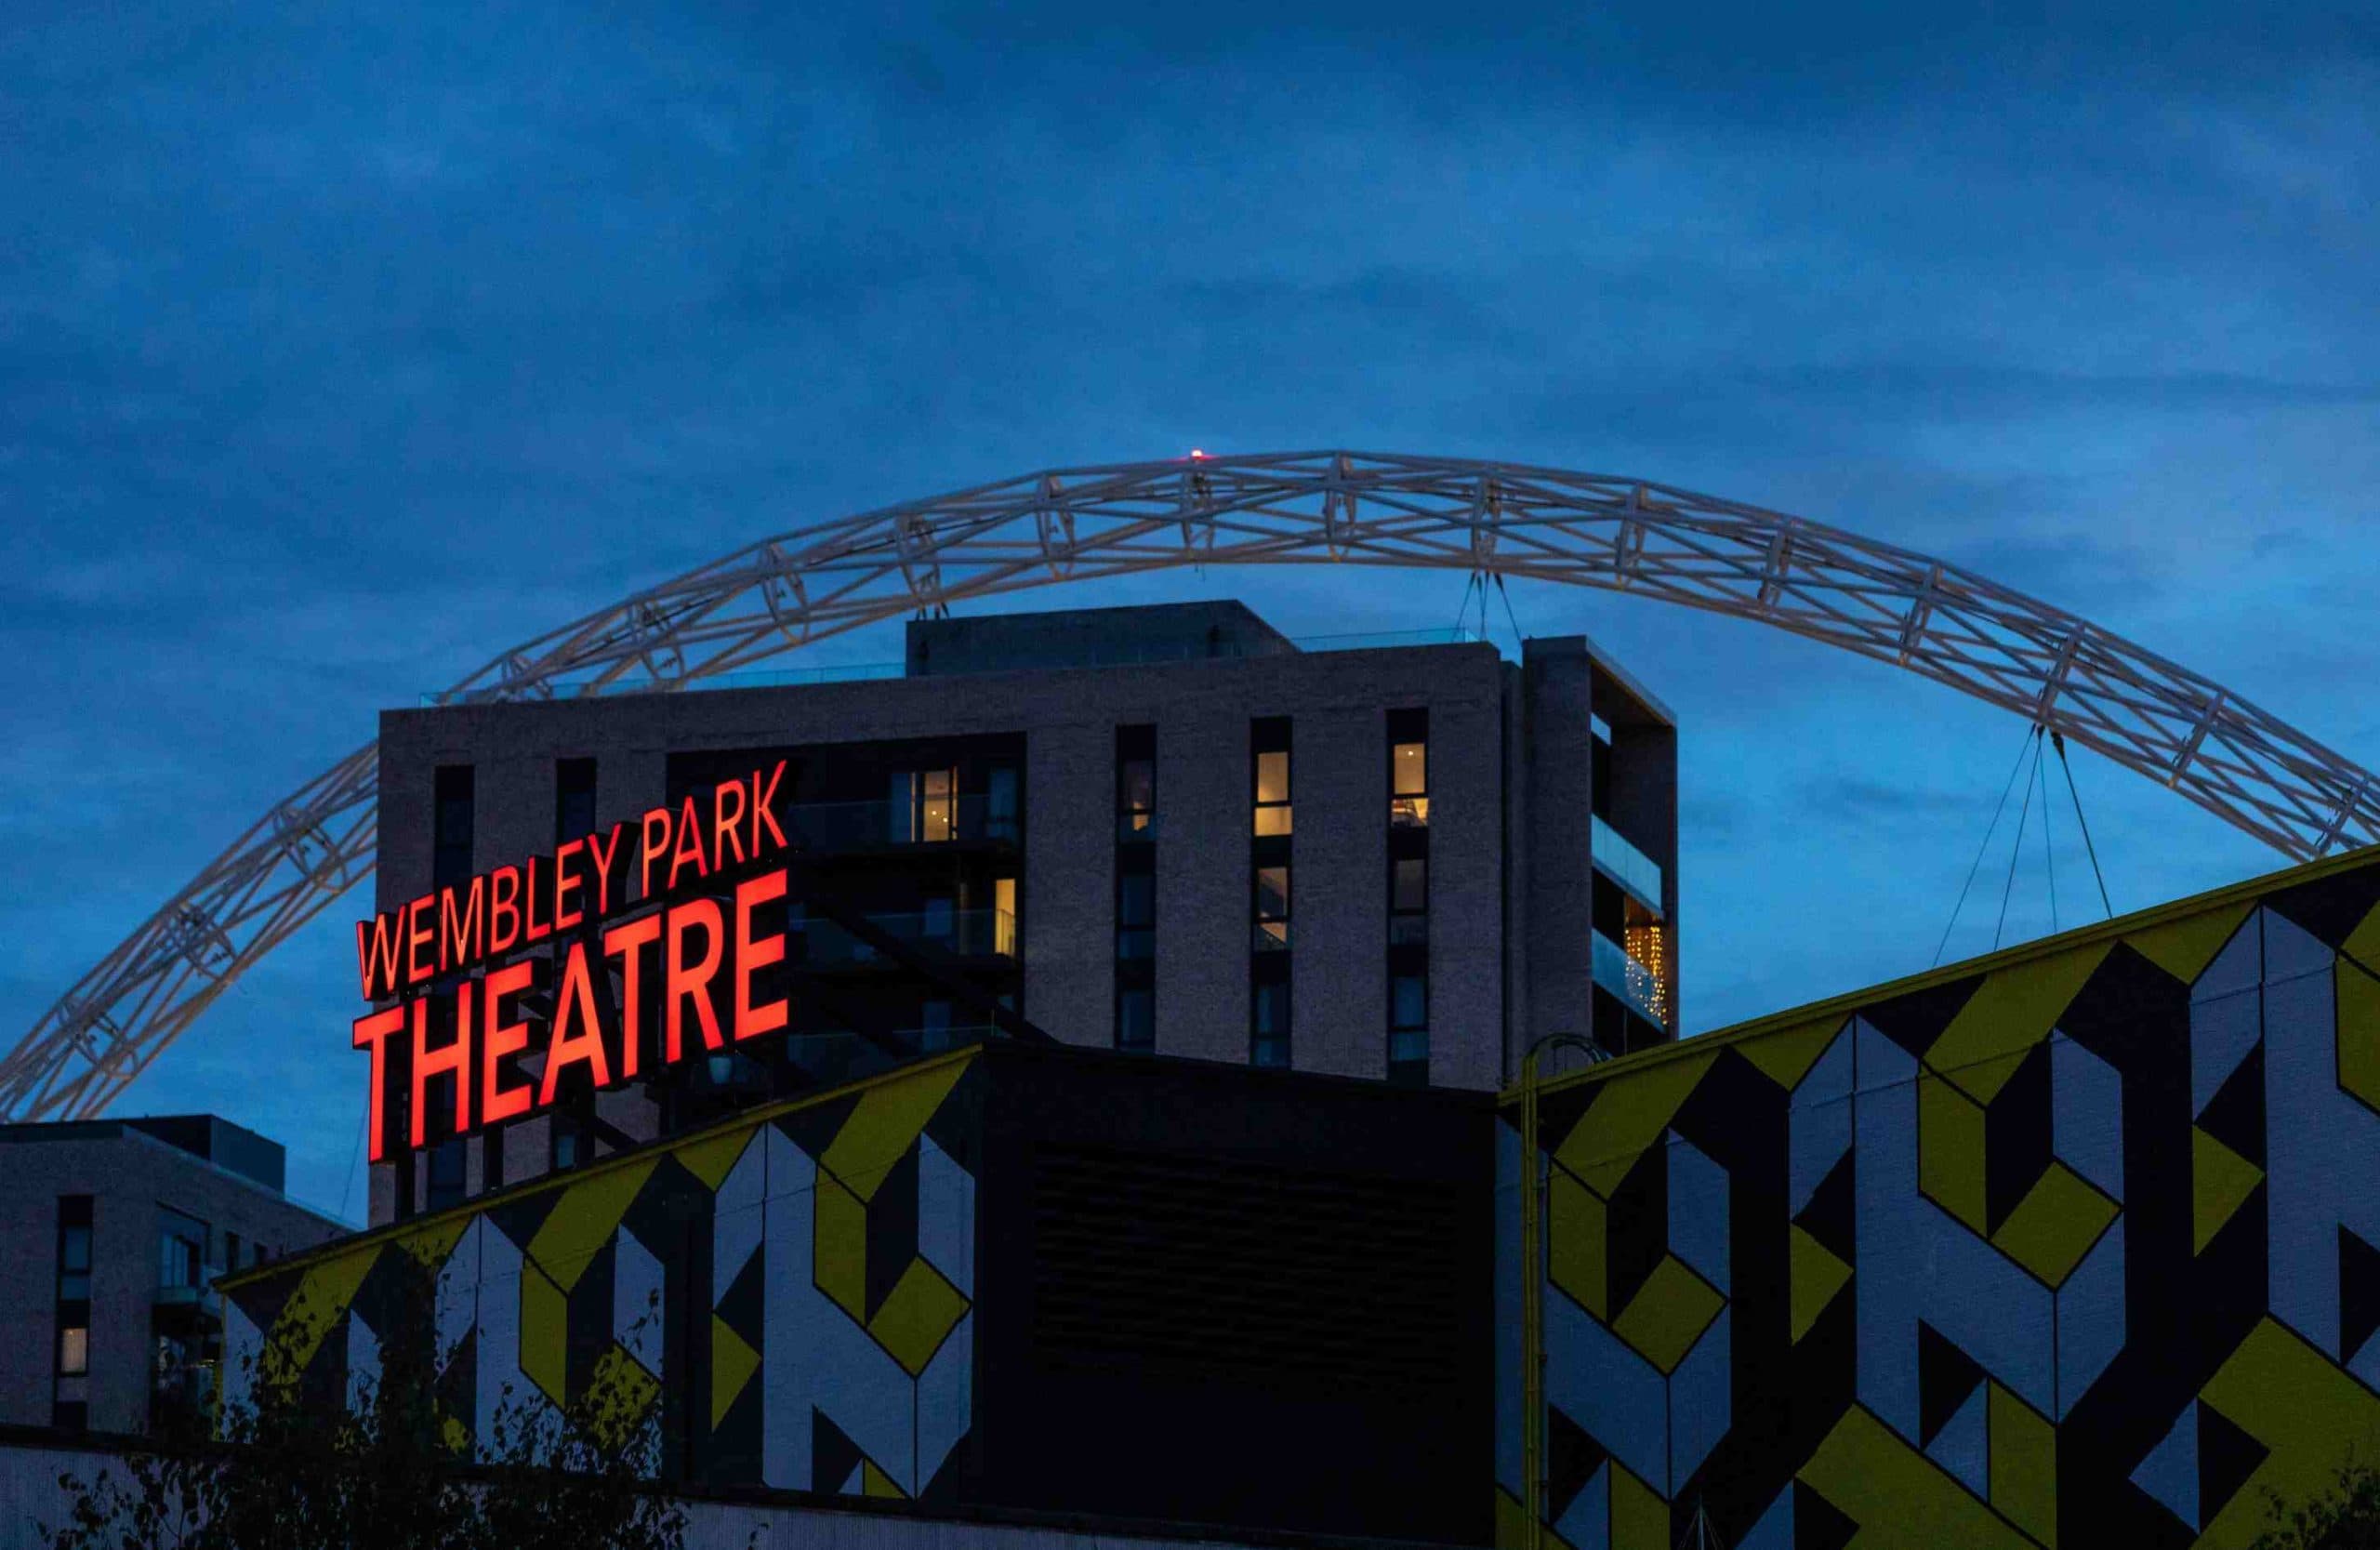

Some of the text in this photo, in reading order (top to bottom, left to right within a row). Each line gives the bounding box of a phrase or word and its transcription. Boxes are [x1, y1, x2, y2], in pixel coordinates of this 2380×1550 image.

[356, 759, 788, 1001] WEMBLEY PARK
[352, 868, 789, 1164] THEATRE
